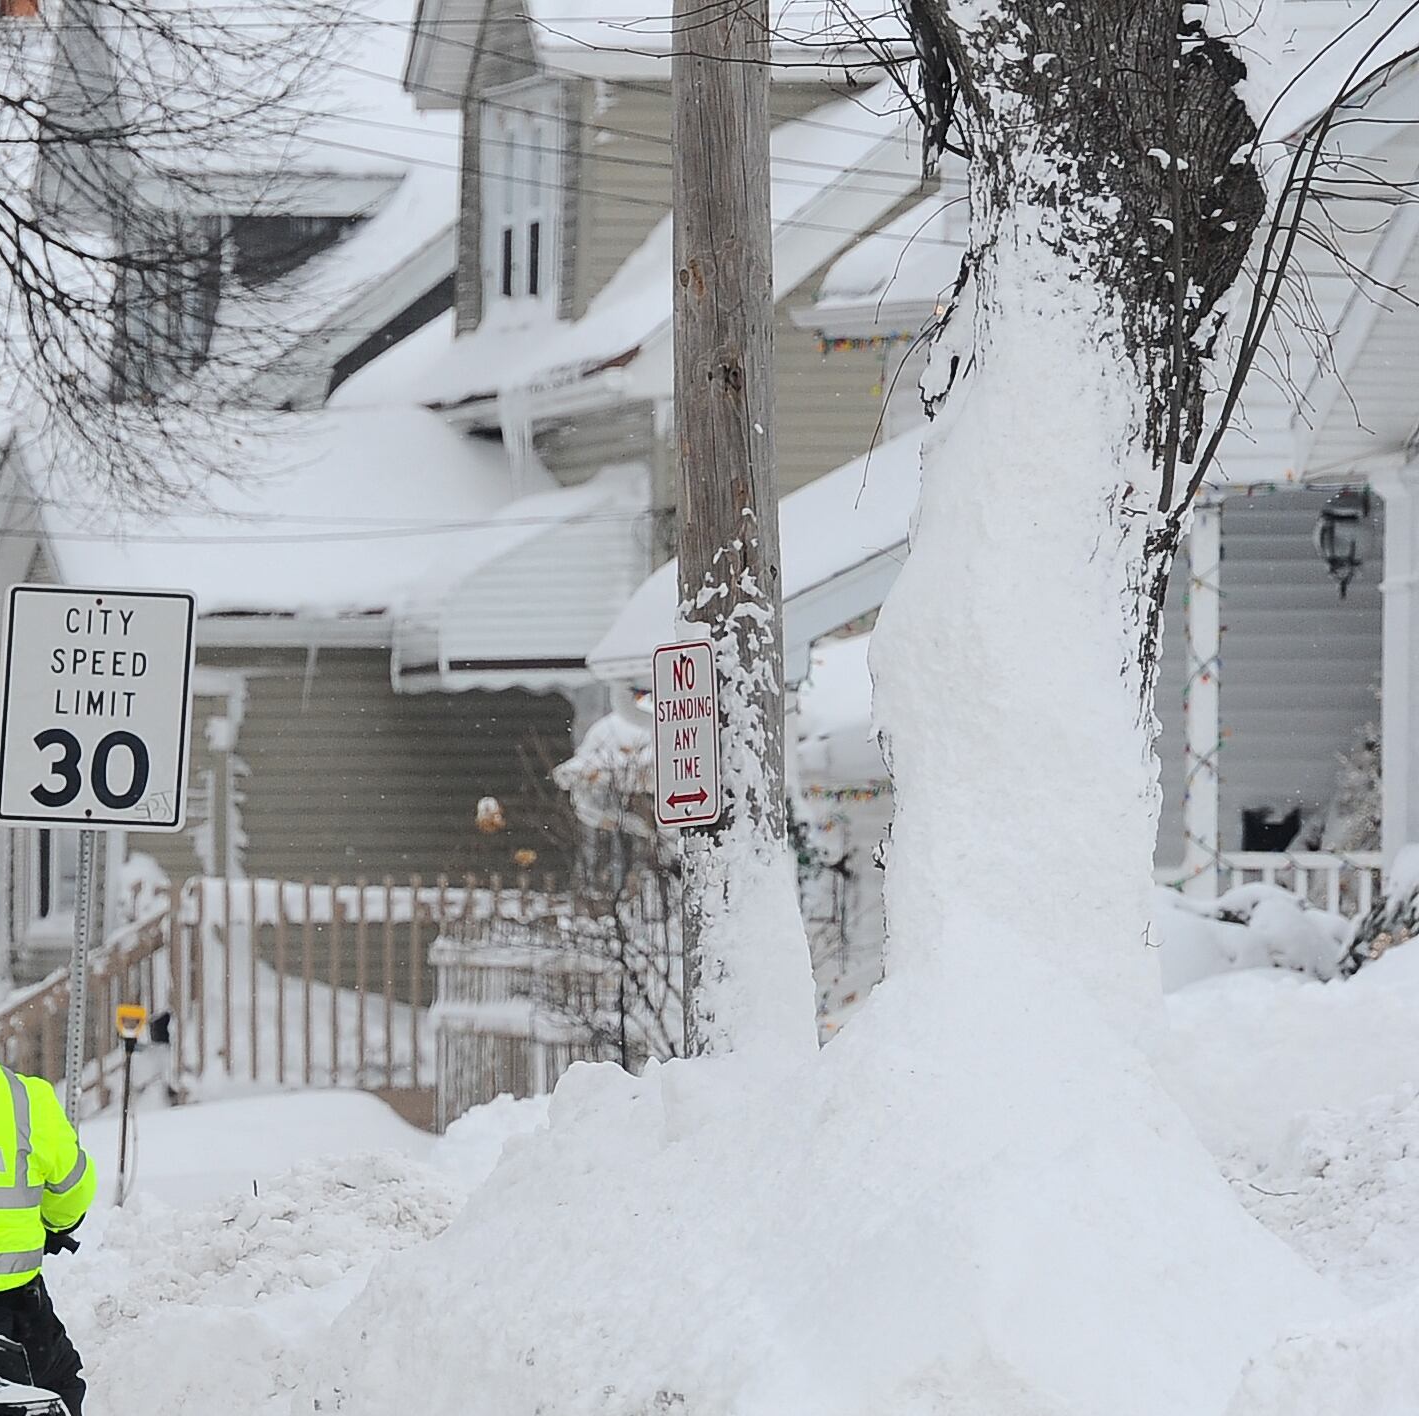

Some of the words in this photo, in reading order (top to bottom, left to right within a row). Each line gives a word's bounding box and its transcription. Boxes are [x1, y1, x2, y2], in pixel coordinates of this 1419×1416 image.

[66, 607, 134, 636] CITY
[50, 648, 147, 677] SPEED
[673, 657, 695, 692] NO
[55, 689, 136, 717] LIMIT
[658, 695, 712, 723] STANDING
[674, 726, 698, 752] ANY
[30, 728, 150, 810] 30
[673, 757, 701, 781] TIME
